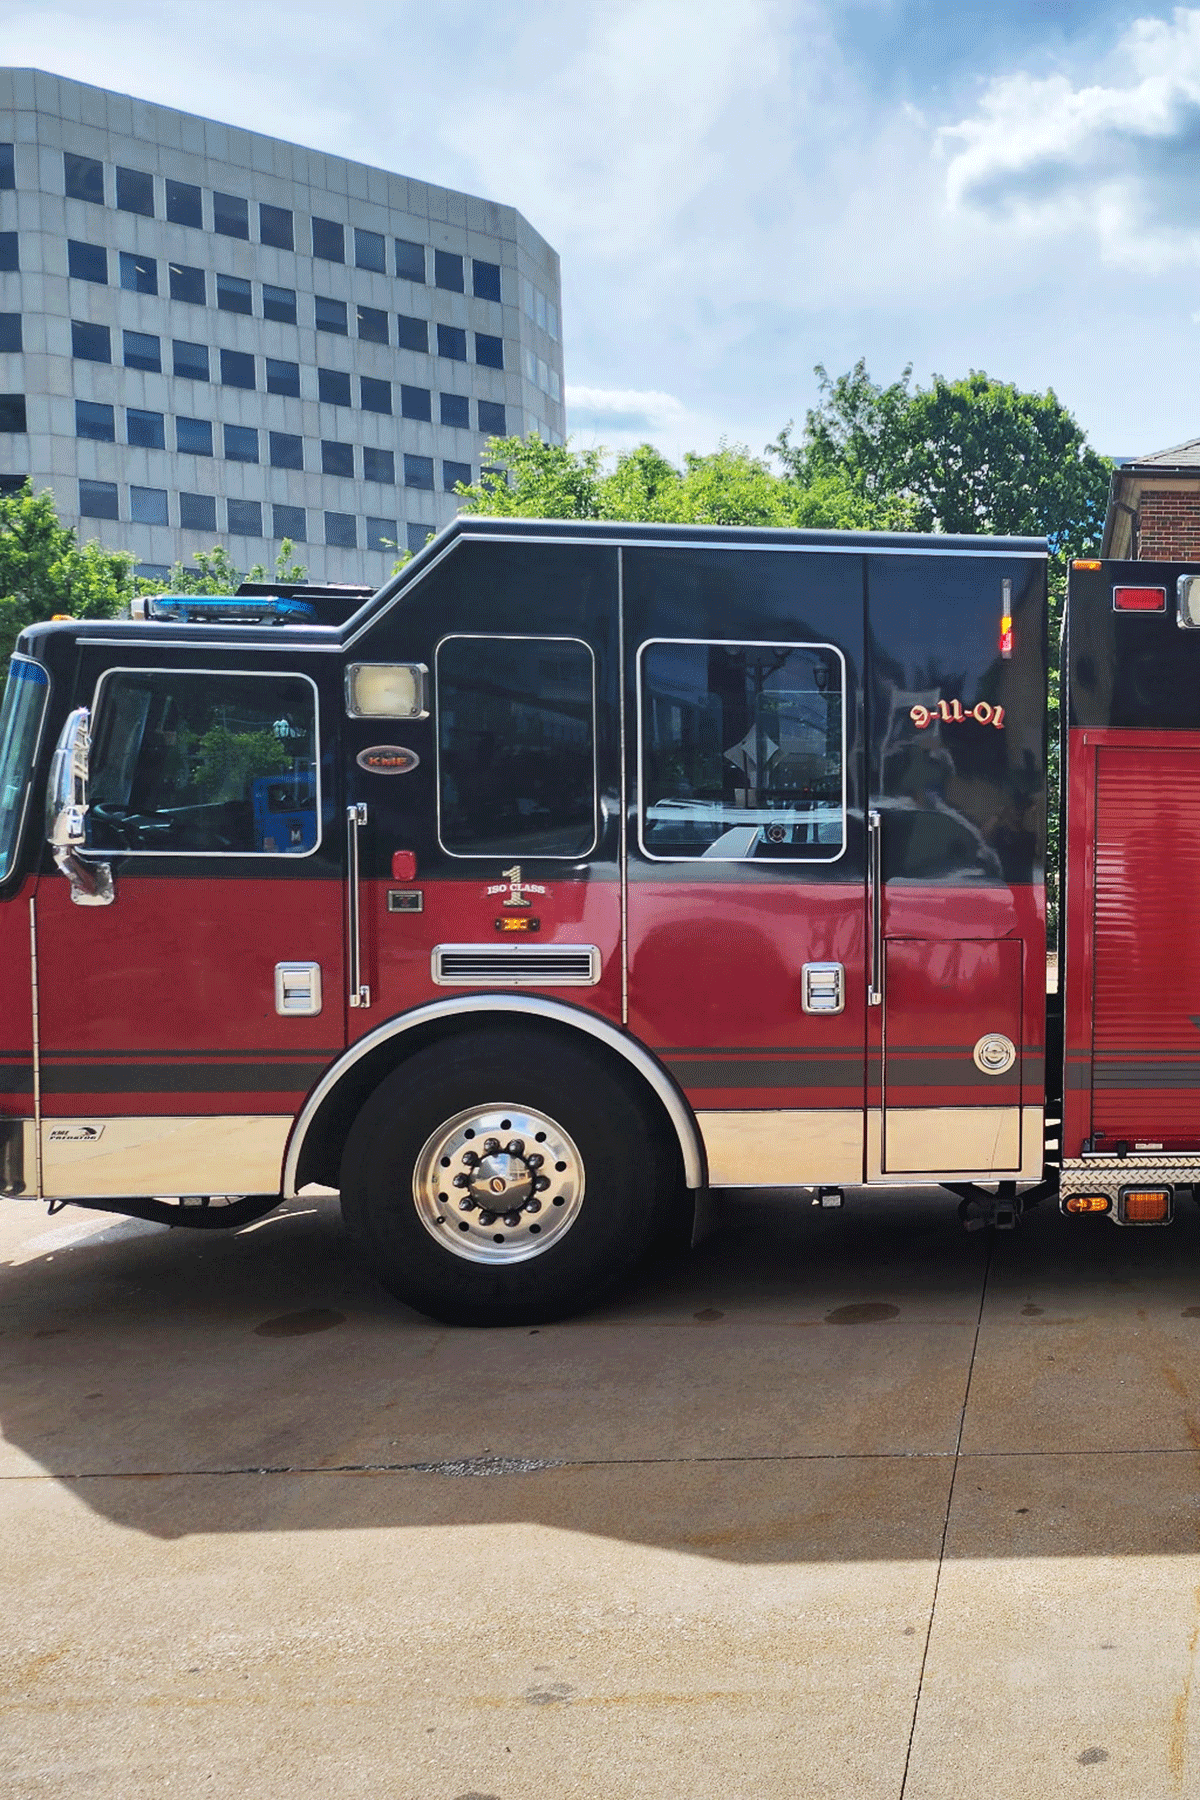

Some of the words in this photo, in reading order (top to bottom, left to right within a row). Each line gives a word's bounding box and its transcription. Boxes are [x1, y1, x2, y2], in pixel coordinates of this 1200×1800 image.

[910, 699, 1005, 729] 9-11-01
[368, 756, 408, 767] KME
[487, 884, 507, 895] ISO
[509, 883, 546, 894] CLASS
